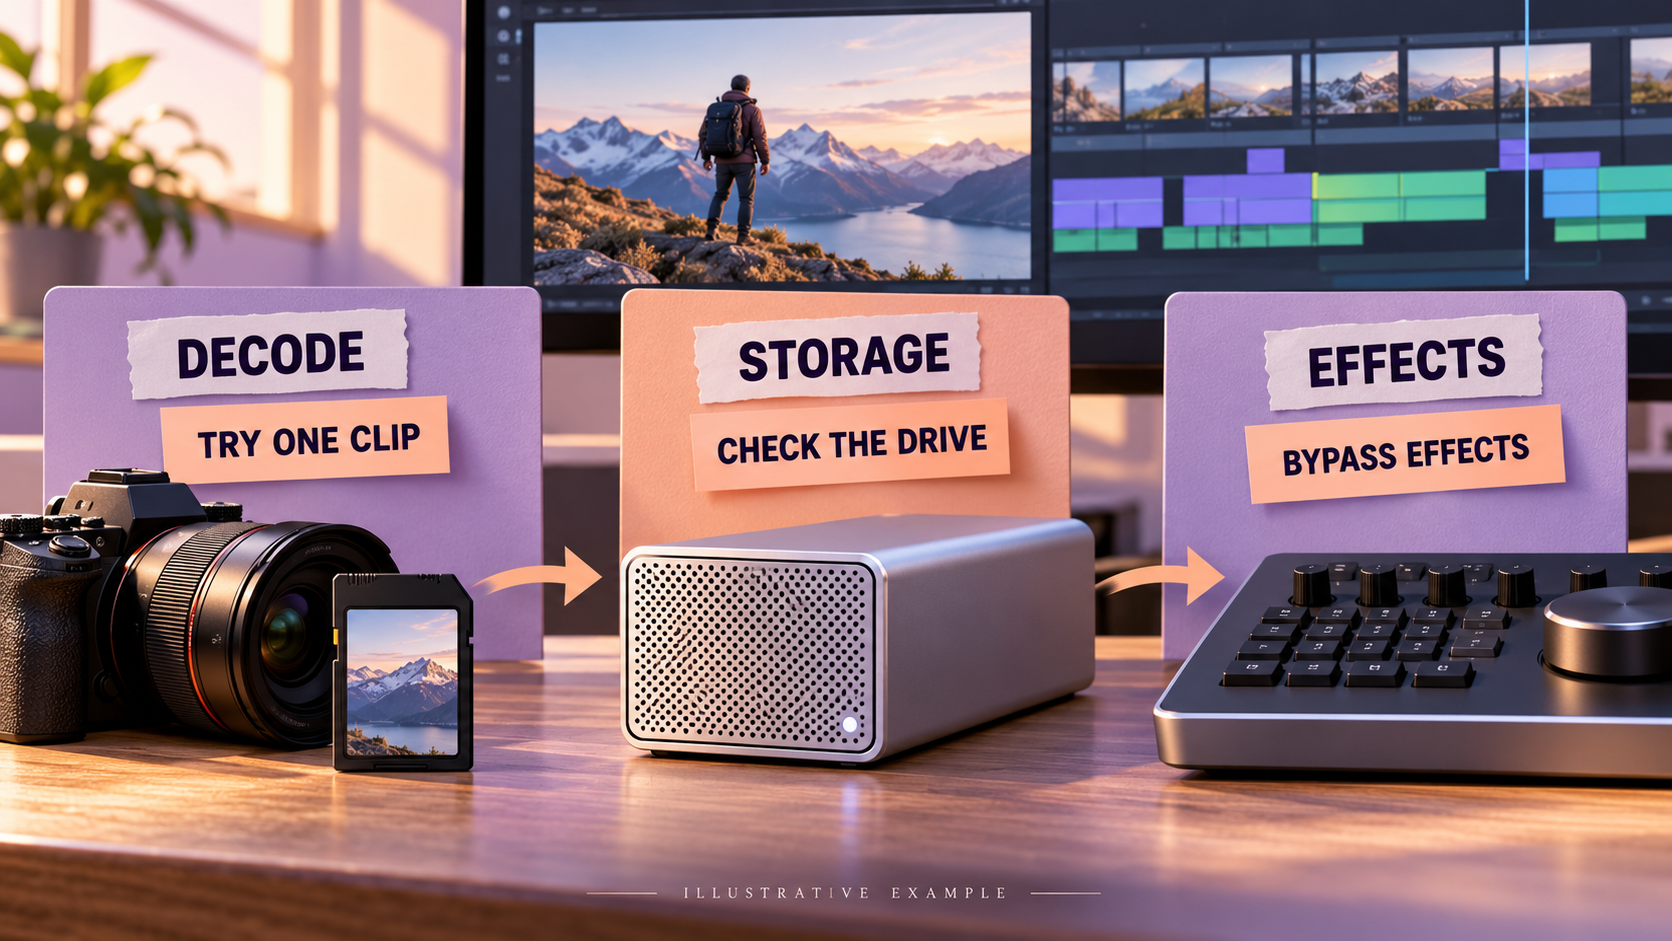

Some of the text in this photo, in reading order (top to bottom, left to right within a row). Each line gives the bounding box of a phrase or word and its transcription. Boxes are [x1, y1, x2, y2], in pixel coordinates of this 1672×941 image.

[178, 330, 365, 379] DECODE
[739, 332, 950, 382] STORAGE
[1308, 336, 1506, 388] EFFECTS
[197, 423, 421, 459] TRY ONE CLIP
[717, 424, 988, 465] CHECK THE DRIVE
[1283, 433, 1530, 477] BYPASS EFFECTS
